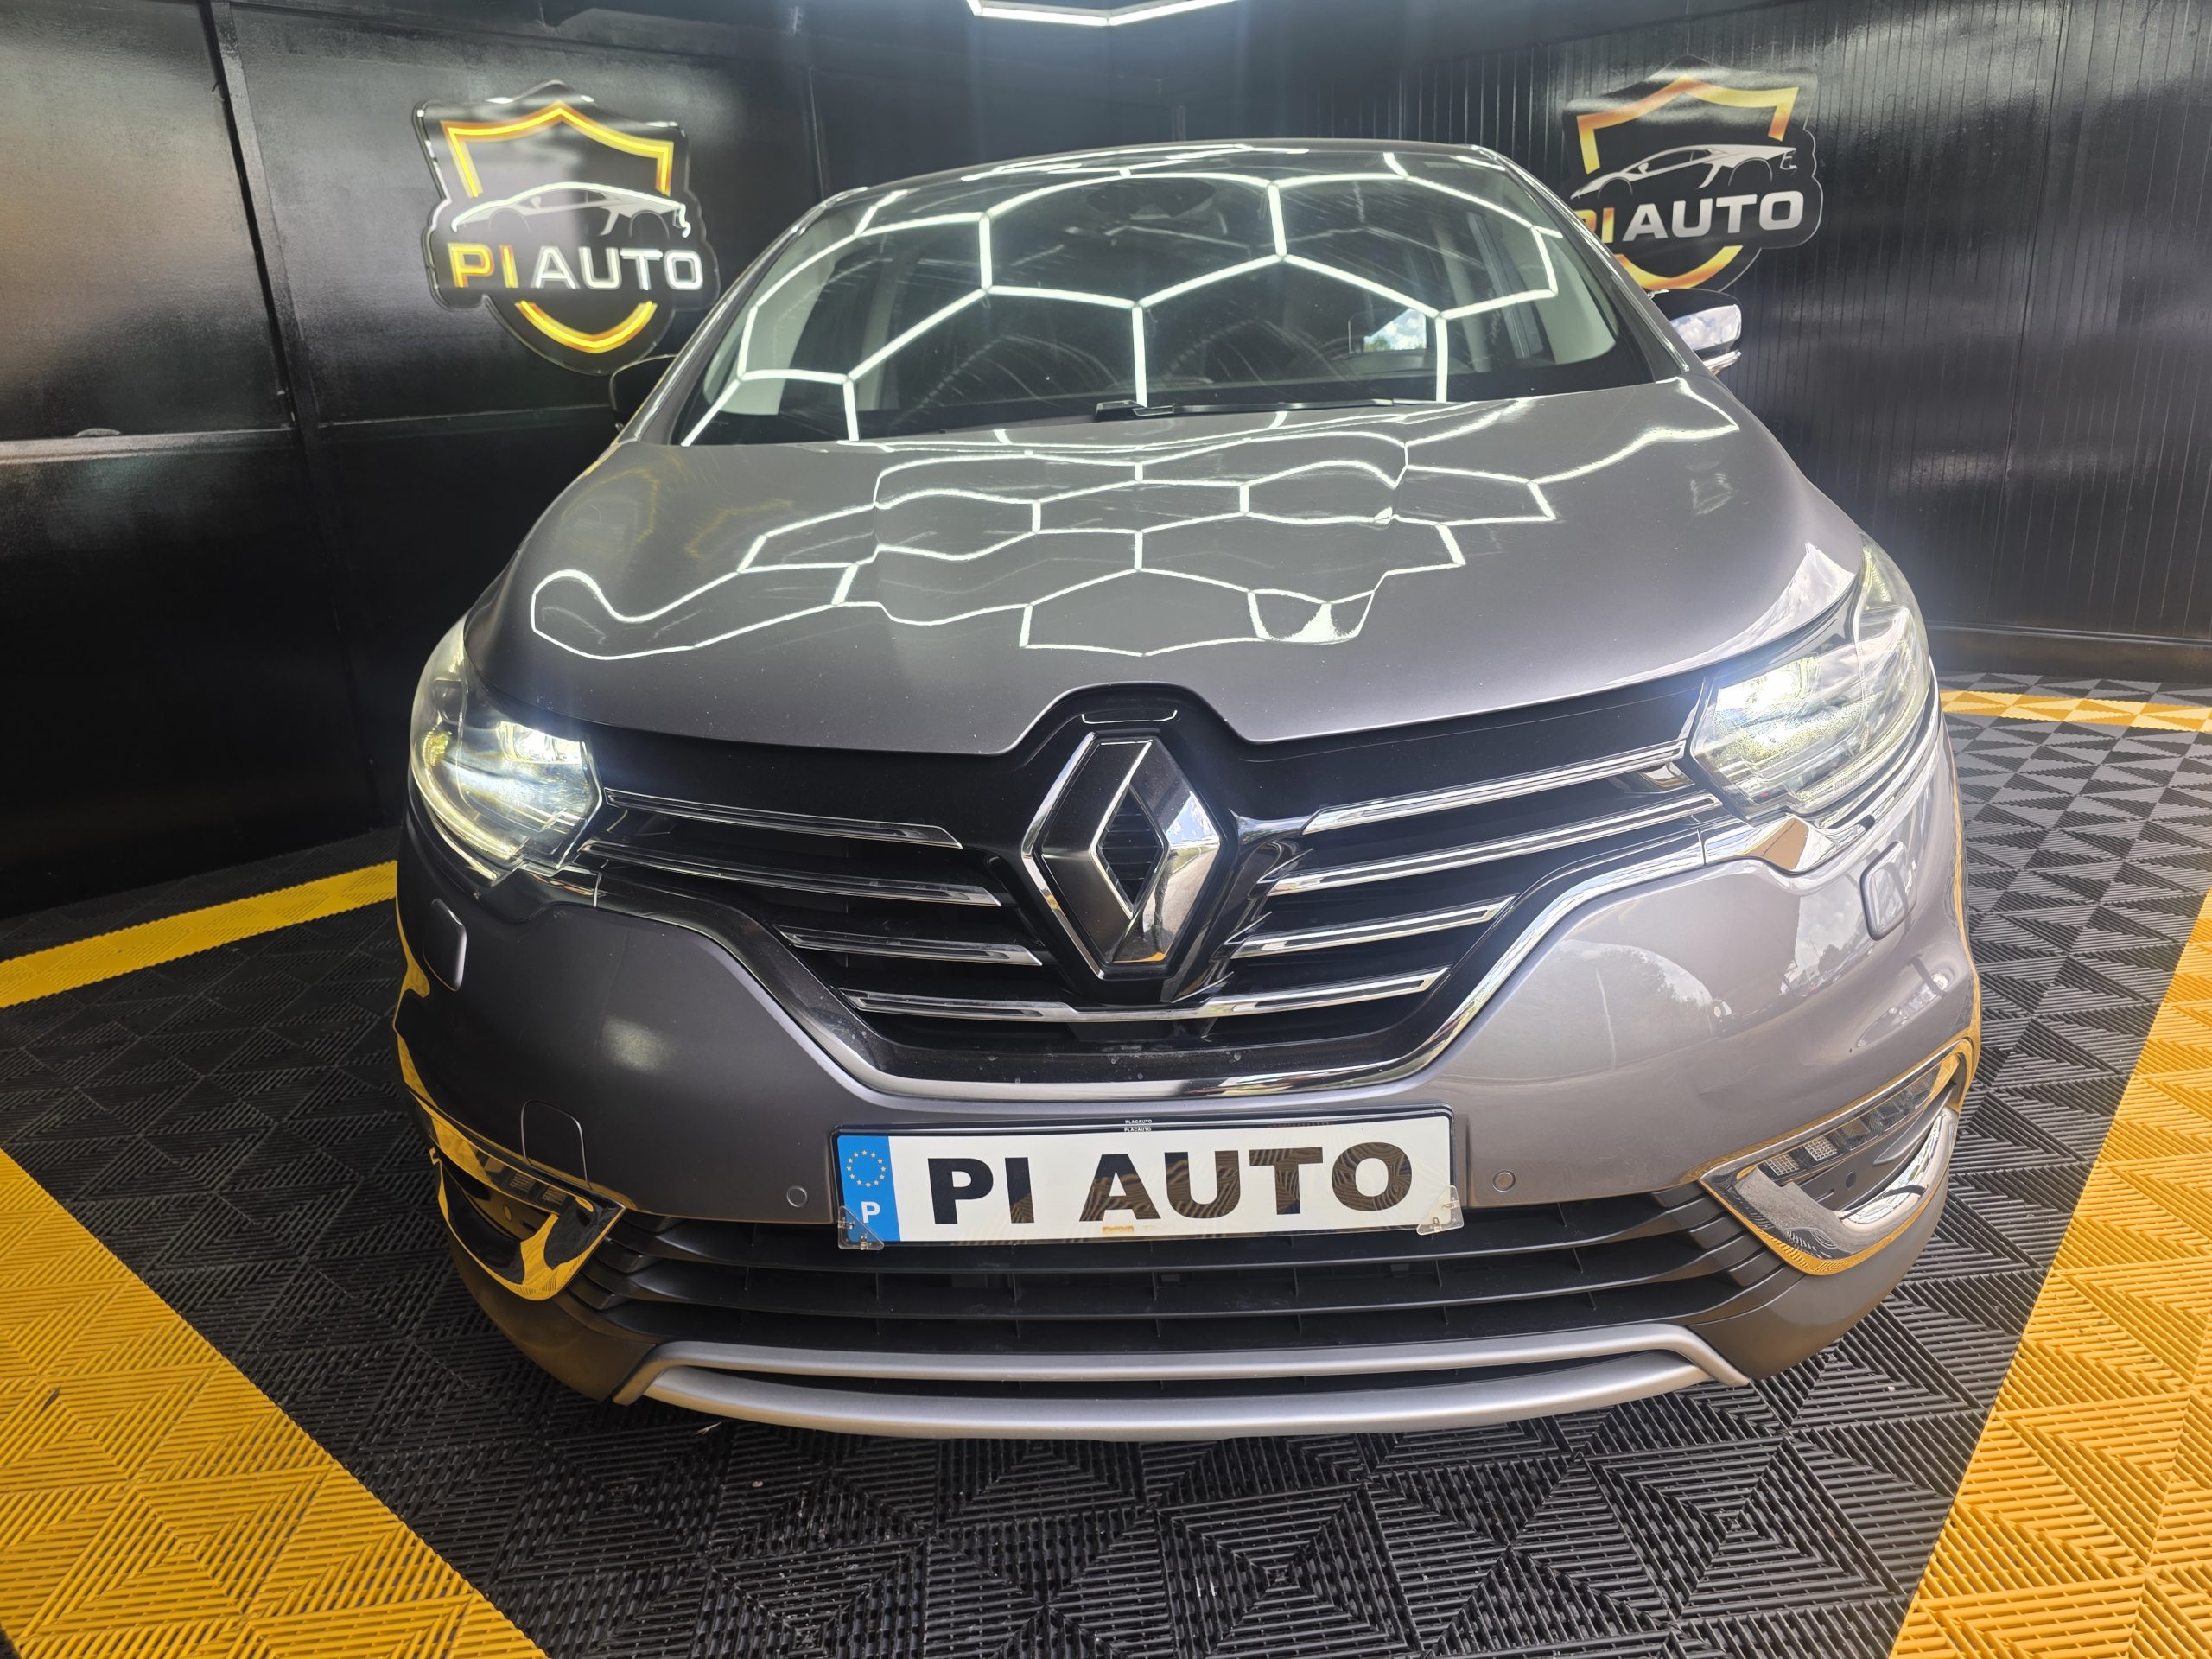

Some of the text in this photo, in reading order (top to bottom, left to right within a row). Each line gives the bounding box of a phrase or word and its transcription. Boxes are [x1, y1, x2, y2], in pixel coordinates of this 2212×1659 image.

[1622, 190, 1804, 242] AUTO
[448, 242, 704, 291] PI AUTO
[927, 1141, 1413, 1225] PI AUTO
[861, 1201, 880, 1224] P
